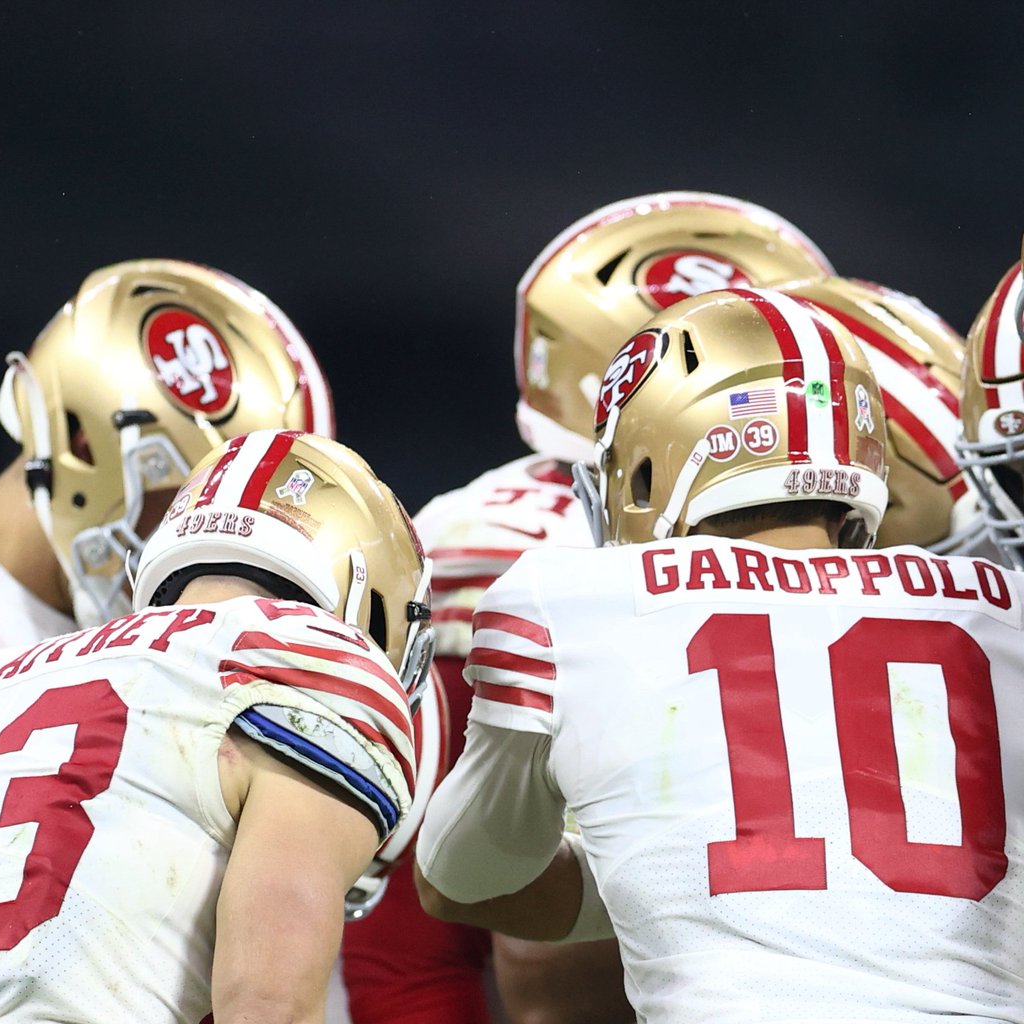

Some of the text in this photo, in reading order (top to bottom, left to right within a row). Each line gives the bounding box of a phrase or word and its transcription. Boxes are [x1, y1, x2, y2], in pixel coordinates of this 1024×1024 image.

[709, 435, 735, 455] JM
[745, 423, 774, 448] 39
[784, 468, 862, 497] 49ERS
[176, 512, 255, 538] 49ERS
[641, 545, 1012, 610] GAROPPOLO
[686, 613, 1010, 902] 10
